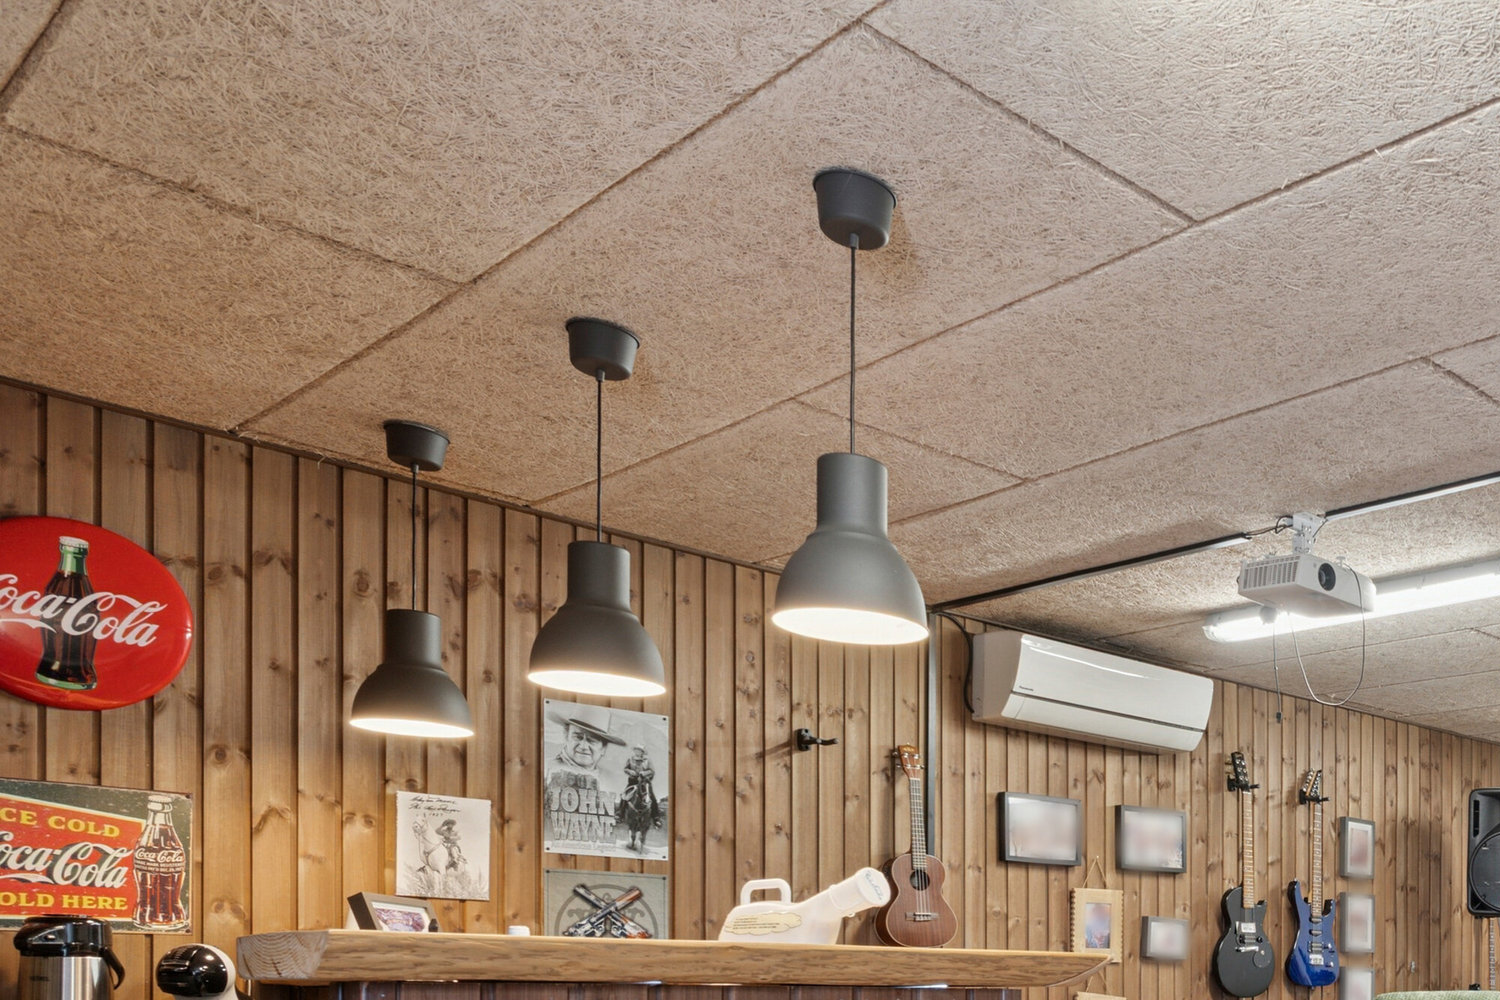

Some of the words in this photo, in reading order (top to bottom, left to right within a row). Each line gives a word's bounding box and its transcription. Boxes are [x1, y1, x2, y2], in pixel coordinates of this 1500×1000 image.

[550, 786, 616, 817] JOHN
[48, 815, 120, 838] COLD
[550, 811, 617, 844] WAYNE
[62, 894, 128, 910] HERE
